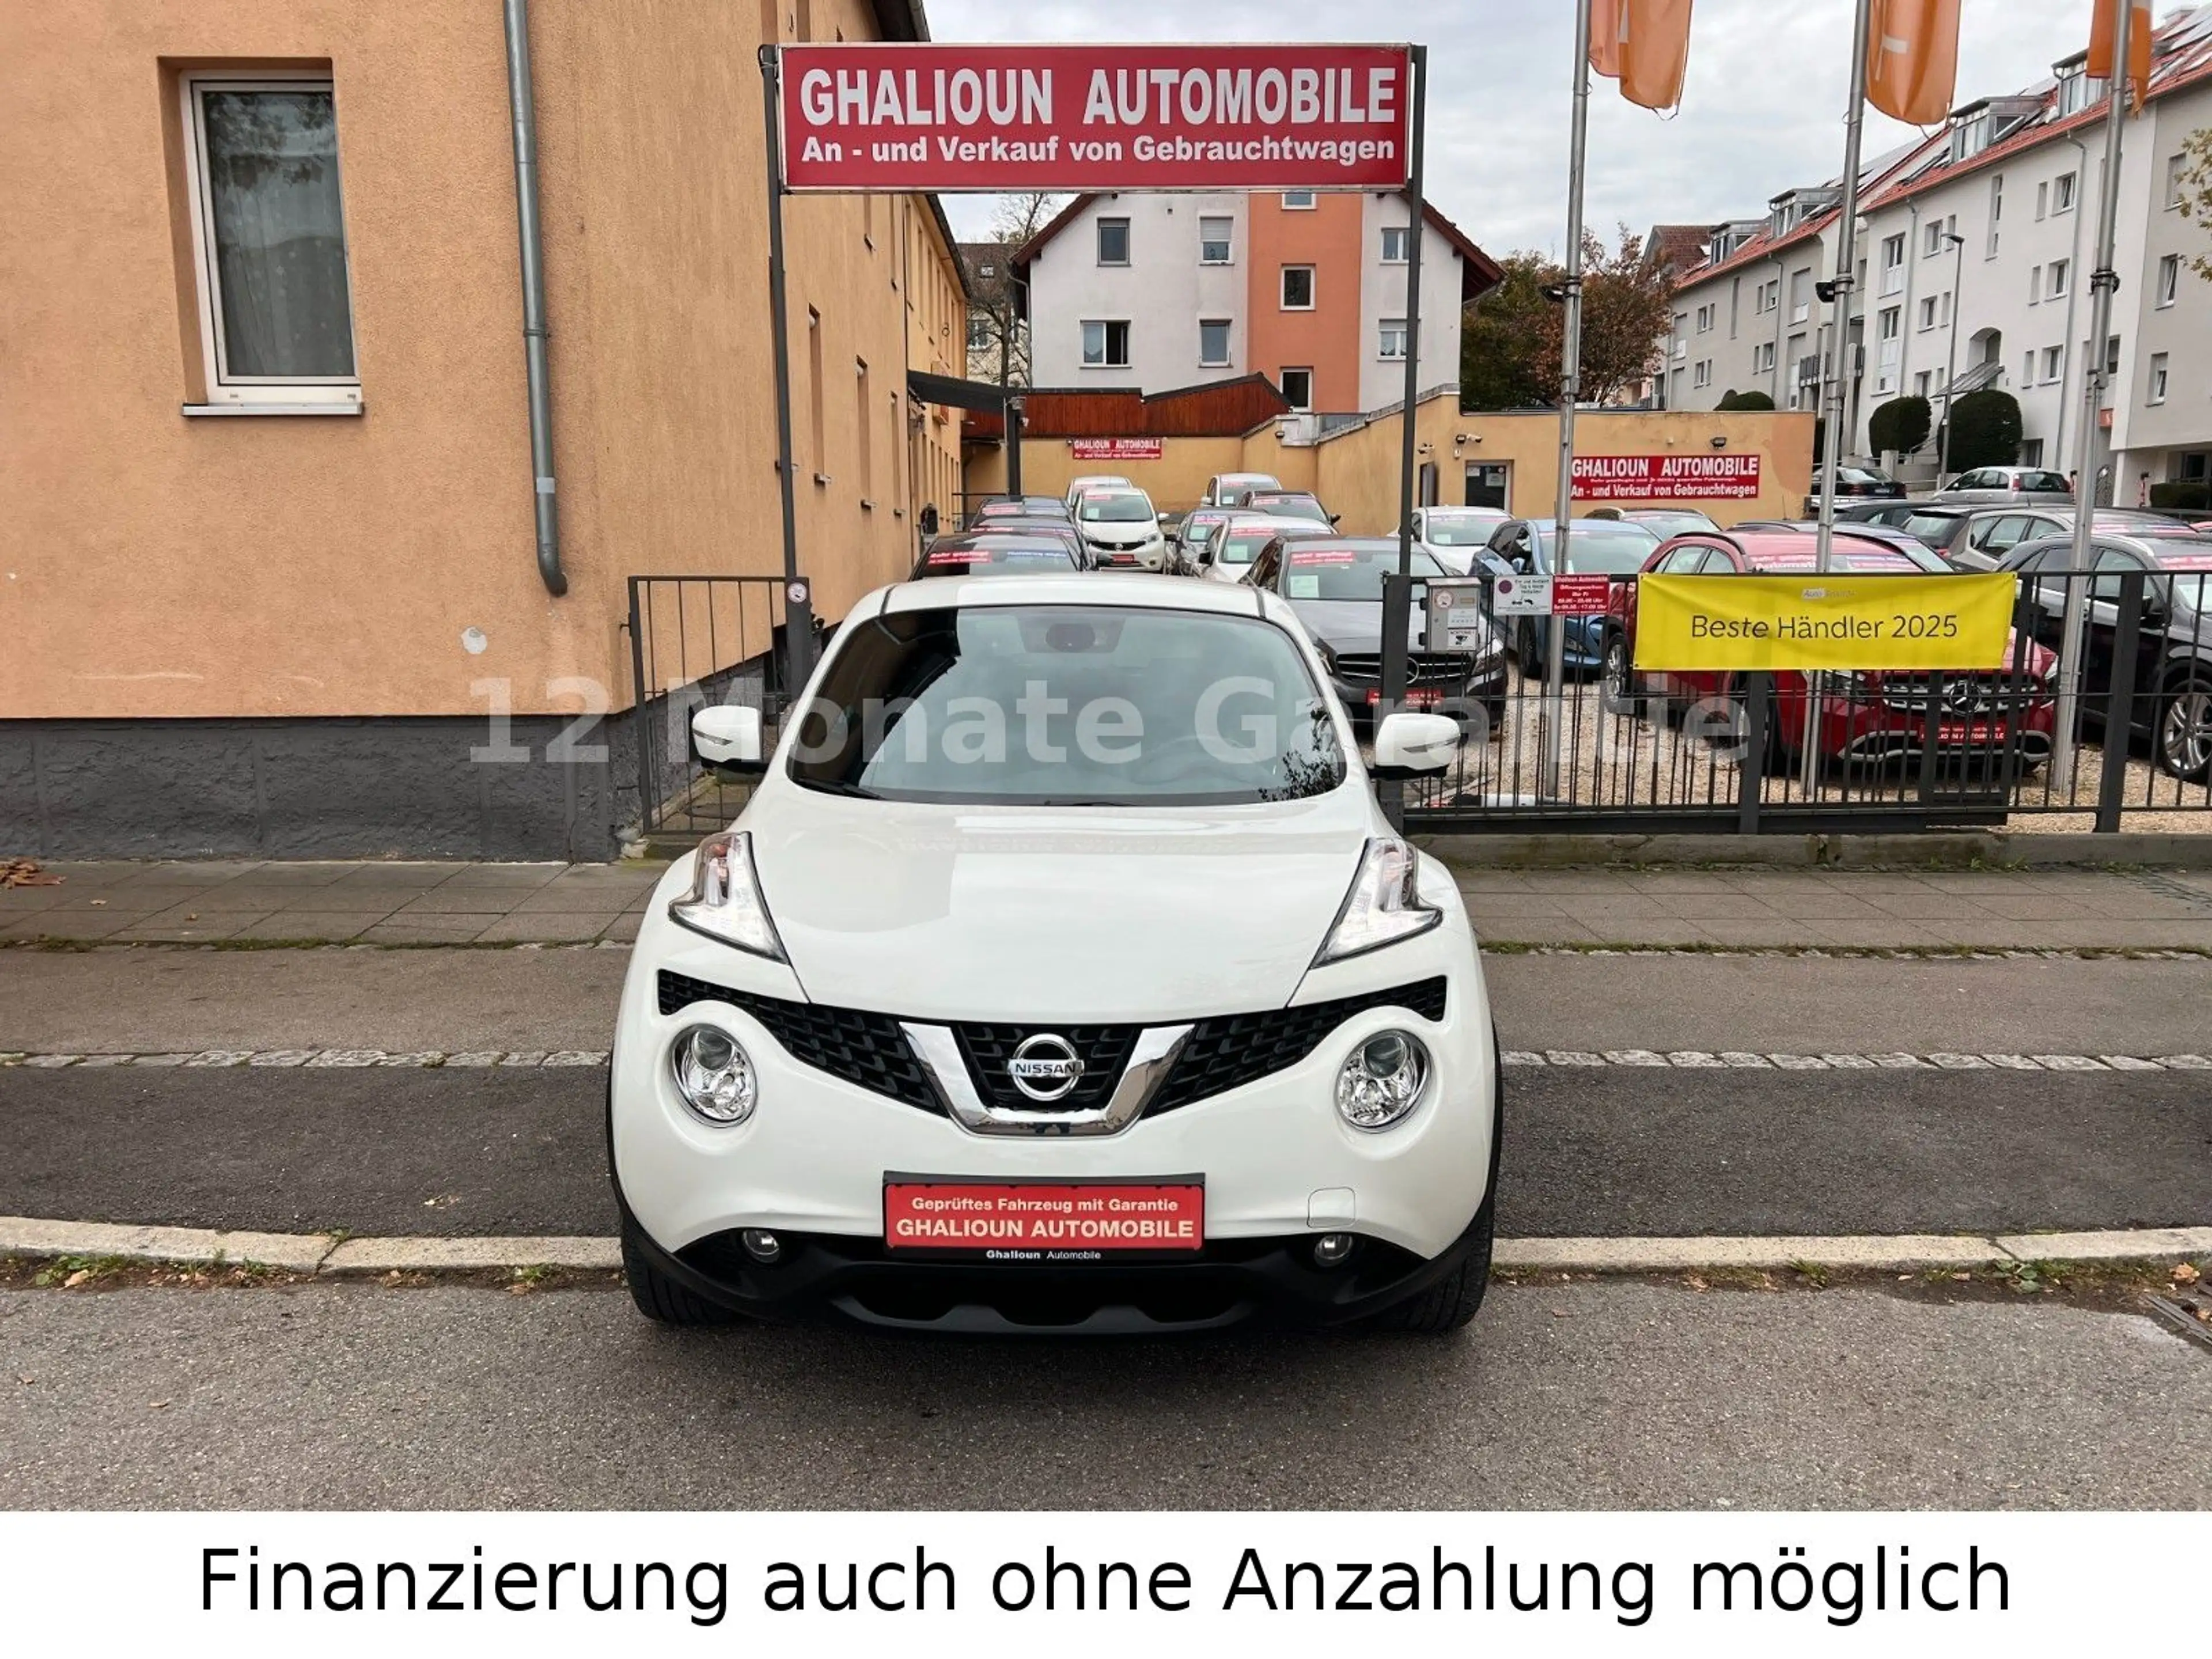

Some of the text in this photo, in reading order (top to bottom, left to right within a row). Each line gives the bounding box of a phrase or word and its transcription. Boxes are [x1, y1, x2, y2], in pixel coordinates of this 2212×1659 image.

[800, 67, 1396, 126] GHALIOUN AUTOMOBILE
[801, 136, 842, 162] An
[872, 136, 927, 162] und
[937, 135, 1059, 162] Verkauf
[1069, 141, 1122, 161] von
[1133, 135, 1395, 166] Gebrauchtwagen
[1571, 457, 1758, 478] GHALIOUN AUTOMOBILE
[1571, 484, 1584, 497] An
[1592, 484, 1611, 497] und
[1613, 483, 1652, 497] Verkauf
[1653, 486, 1671, 496] von
[1673, 483, 1756, 498] Gebrauchtwagen
[1691, 615, 1958, 639] Beste Händler 2025
[1016, 1063, 1075, 1074] NISSAN
[912, 1197, 1179, 1213] Geprüftes Fahrzeug mit Garantie
[896, 1218, 1194, 1238] GHALIOUN AUTOMOBILE
[986, 1250, 1101, 1260] Ghalioun Automobile
